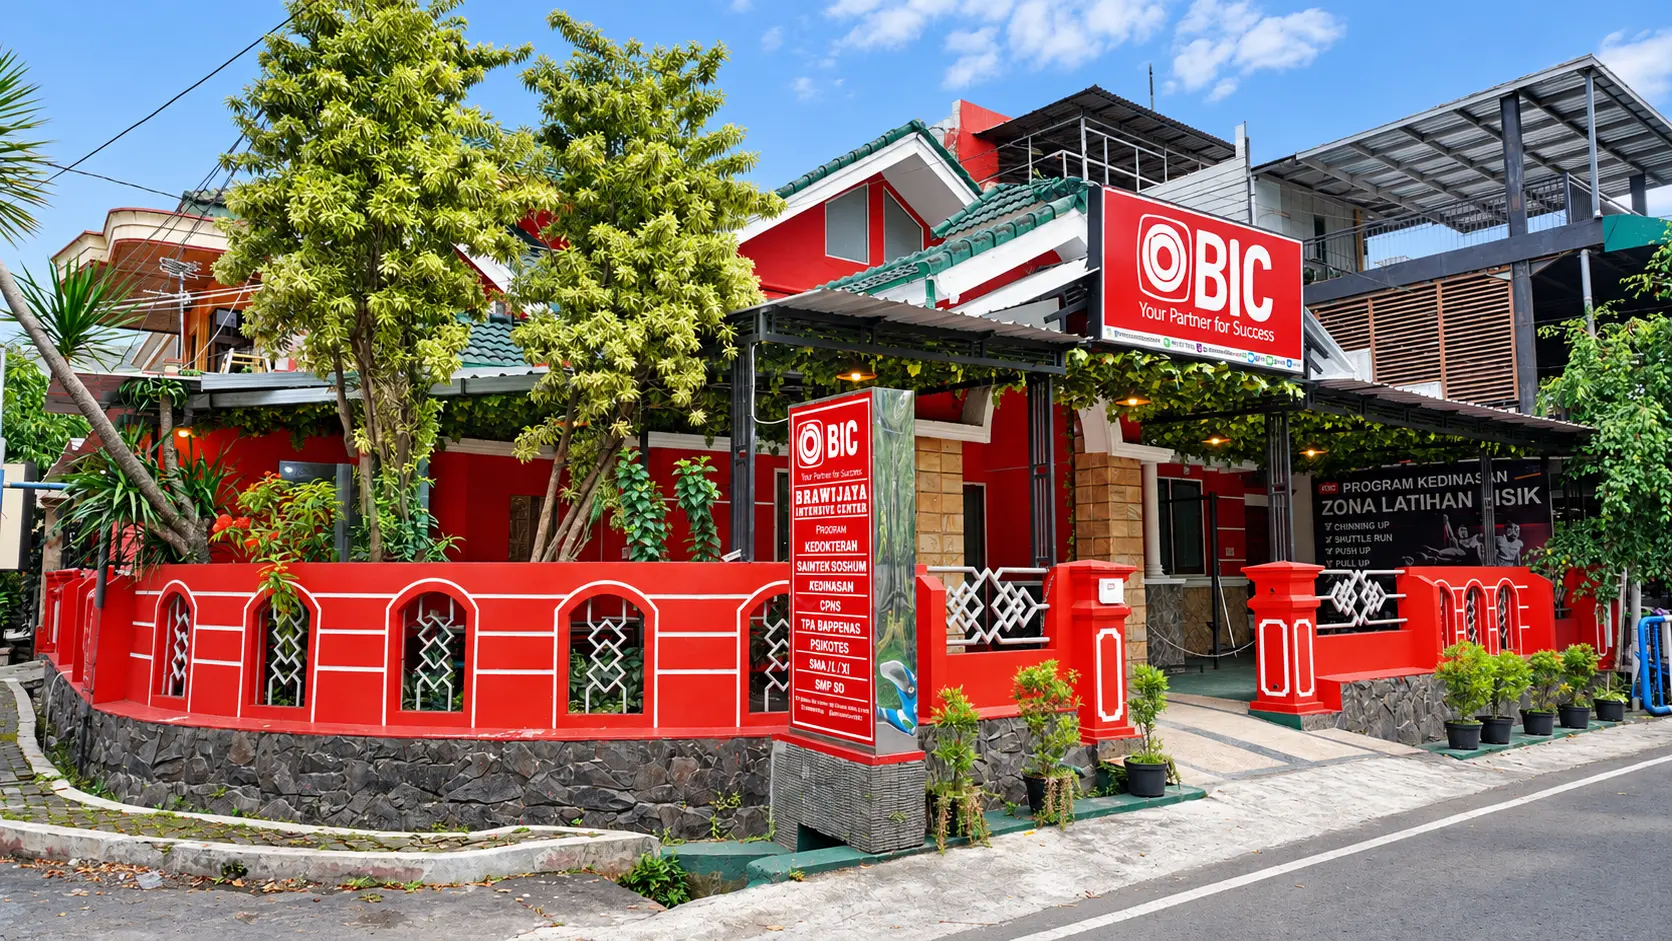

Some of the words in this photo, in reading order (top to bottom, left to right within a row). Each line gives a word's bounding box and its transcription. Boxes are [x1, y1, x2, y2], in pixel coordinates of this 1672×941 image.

[1195, 229, 1274, 322] BIC
[1139, 301, 1167, 321] Your
[1170, 307, 1212, 330] Partner
[1214, 316, 1231, 334] for
[1233, 321, 1275, 342] Success
[827, 420, 858, 458] BIC
[796, 484, 867, 505] BRAWIJAYA
[1343, 478, 1413, 493] PROGRAM
[1322, 498, 1376, 515] ZONA
[1382, 490, 1472, 512] LATIHAN
[1495, 487, 1541, 505] ISIK
[1335, 522, 1375, 530] CHINNING
[831, 561, 866, 572] SOSHUM
[801, 619, 815, 630] TPA
[818, 620, 861, 634] BAPPENAS
[815, 679, 832, 691] SMP
